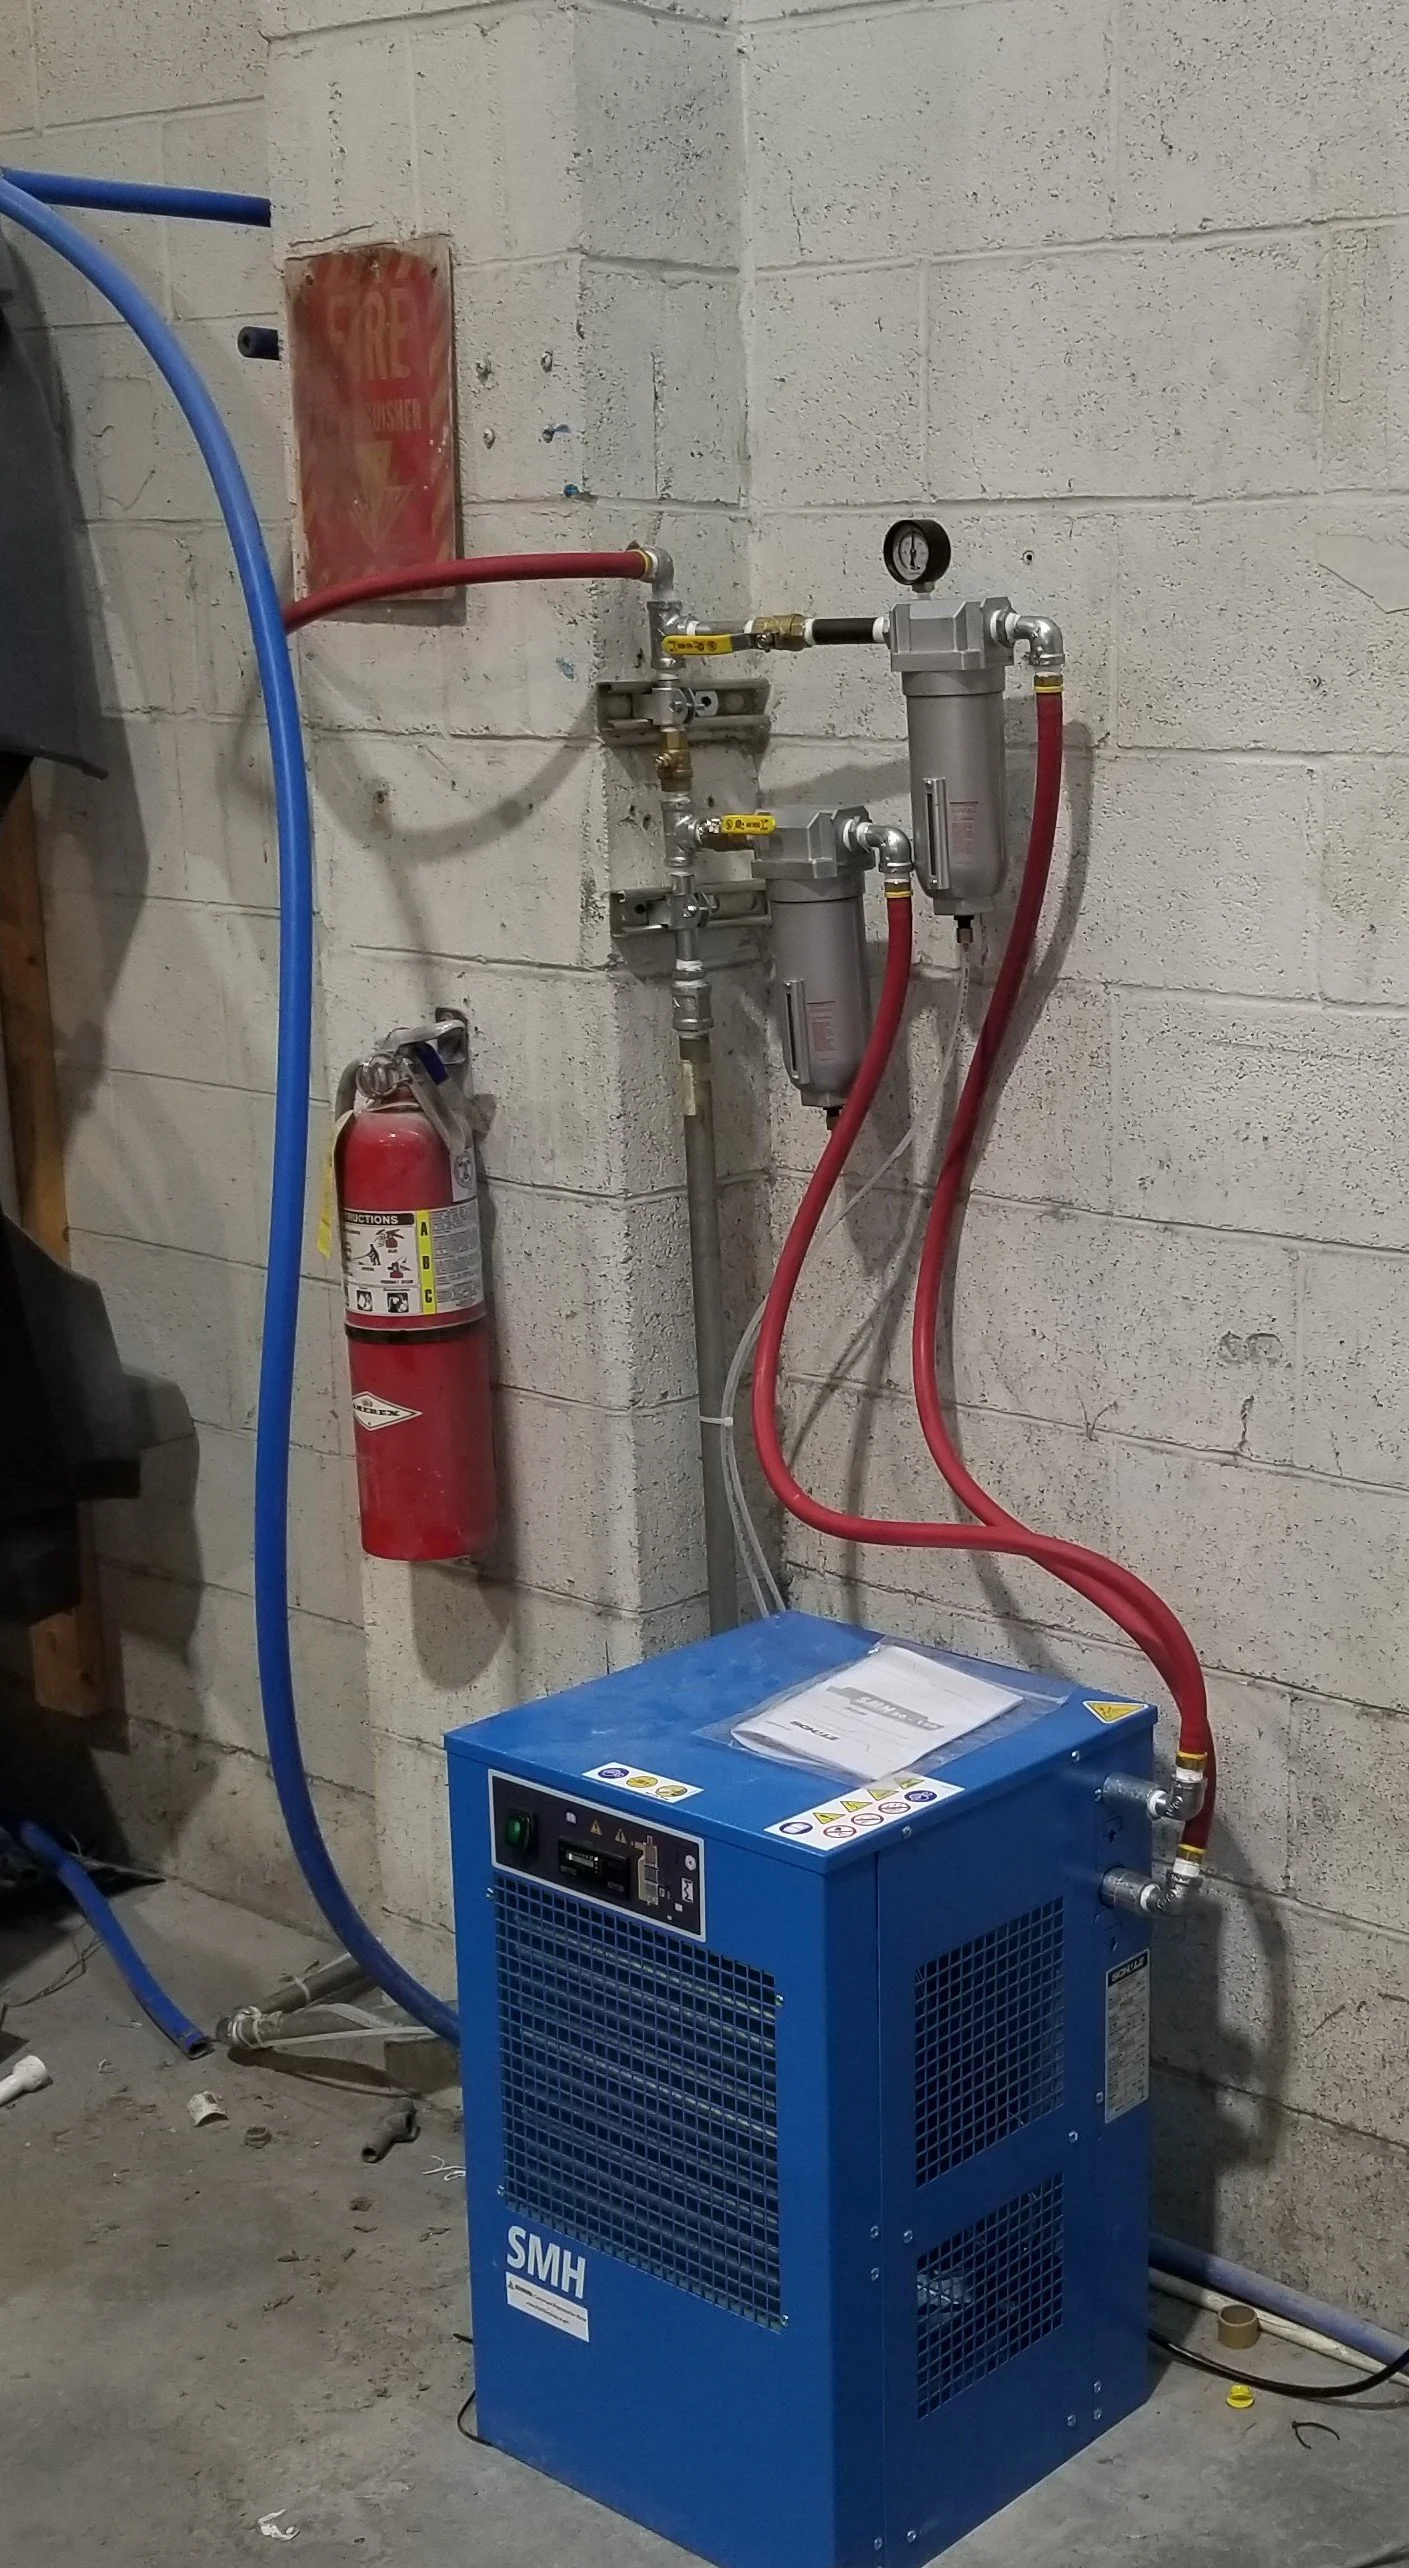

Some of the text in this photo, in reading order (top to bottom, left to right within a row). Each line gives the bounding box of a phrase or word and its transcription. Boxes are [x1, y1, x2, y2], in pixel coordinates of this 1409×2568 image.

[420, 1221, 429, 1237] A
[422, 1255, 430, 1270] B
[424, 1289, 433, 1304] C
[506, 2225, 586, 2300] SMH
